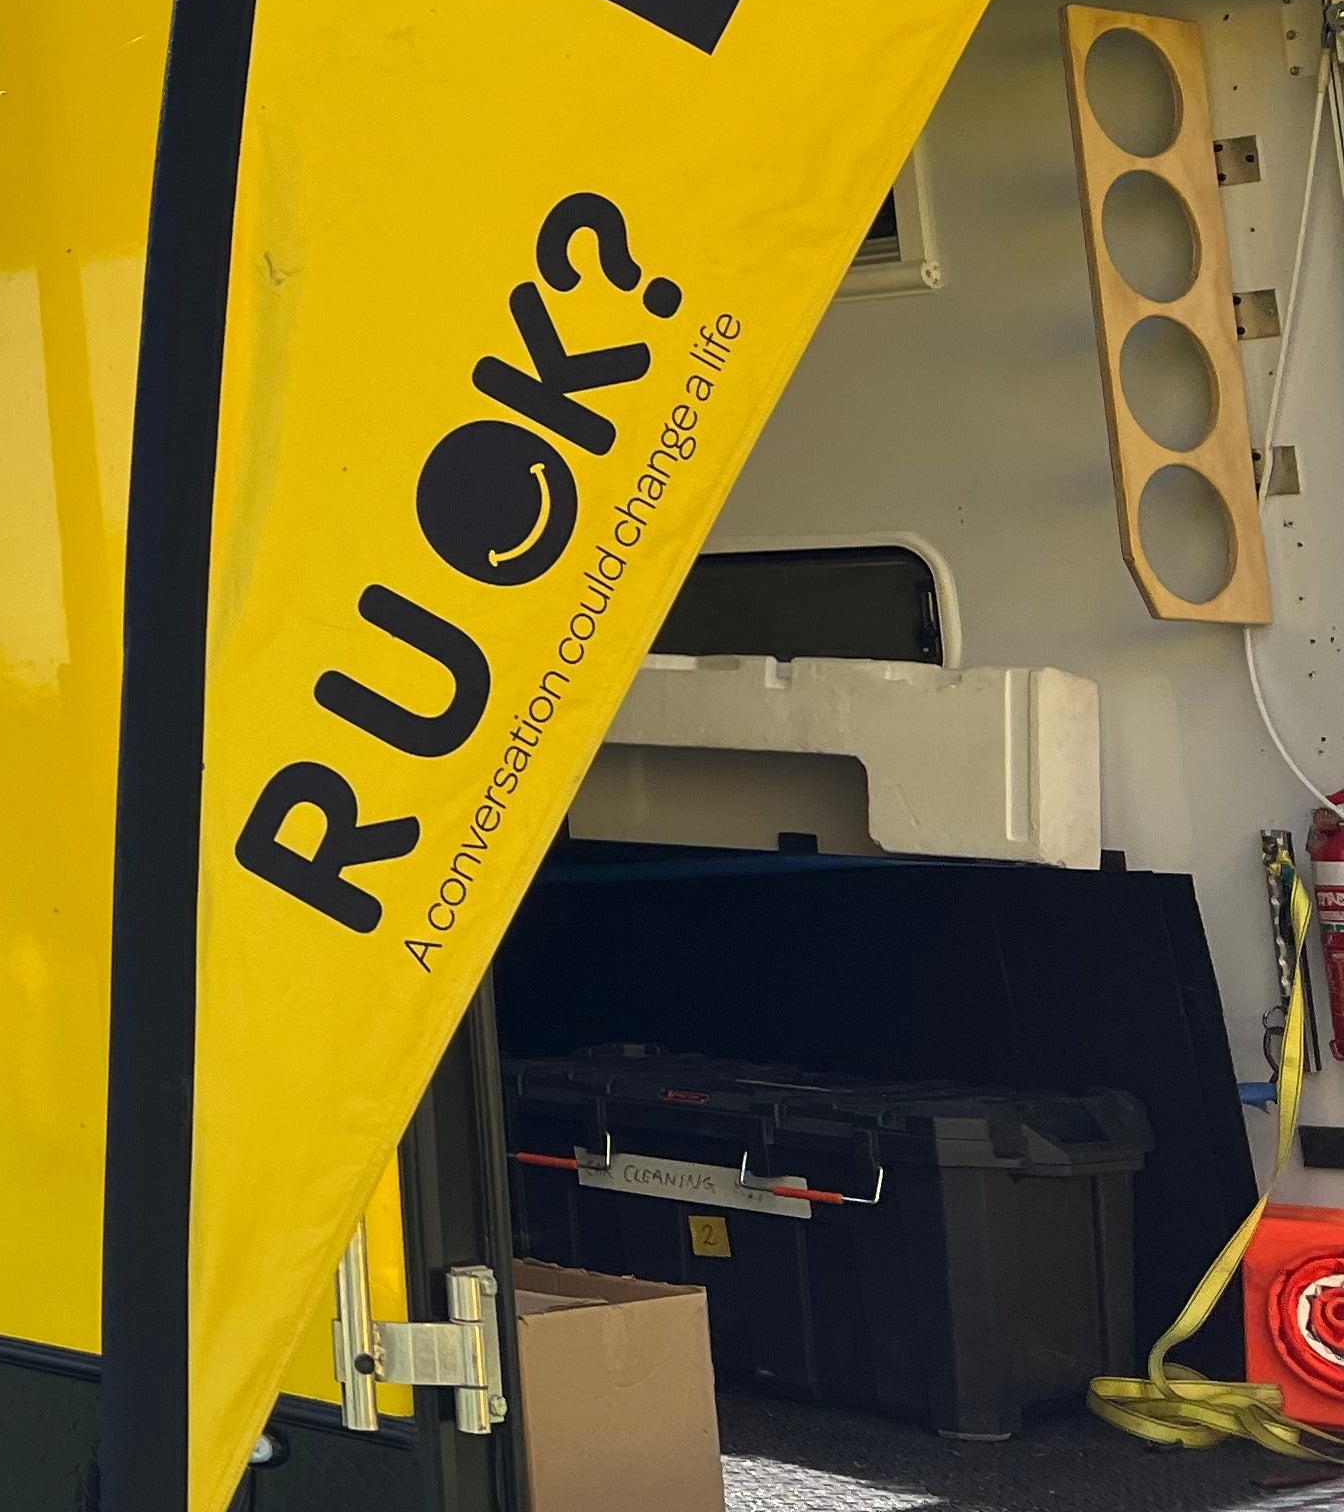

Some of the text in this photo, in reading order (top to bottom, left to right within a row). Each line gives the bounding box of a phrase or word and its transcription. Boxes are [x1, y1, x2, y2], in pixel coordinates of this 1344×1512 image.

[404, 313, 742, 973] A conversation could change a life
[623, 1163, 716, 1191] CLEANING
[701, 1223, 717, 1247] 2
